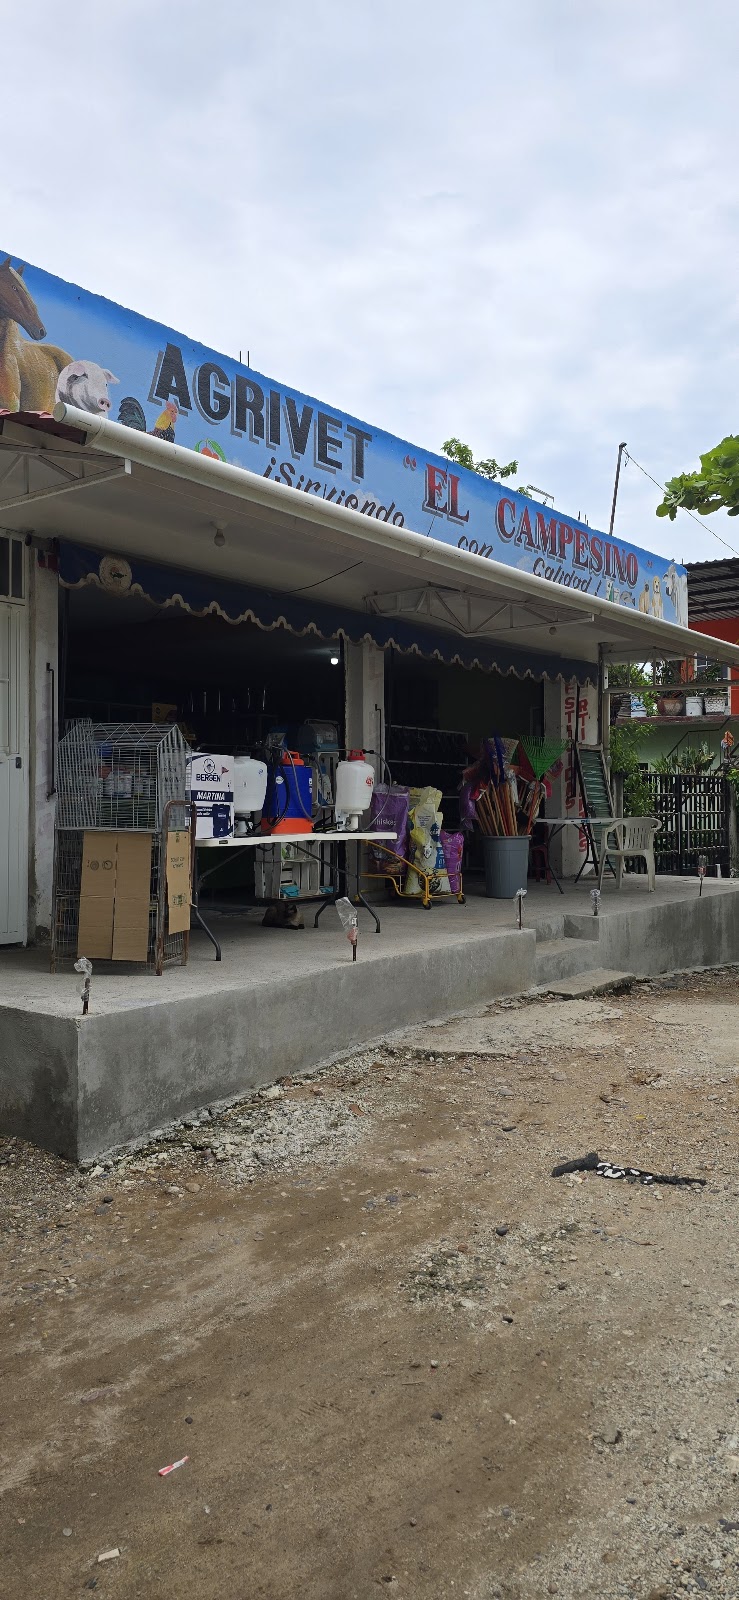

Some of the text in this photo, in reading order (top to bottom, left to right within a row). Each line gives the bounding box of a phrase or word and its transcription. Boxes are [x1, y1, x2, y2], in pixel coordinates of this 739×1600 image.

[148, 343, 372, 482] AGRIVET
[495, 497, 640, 588] CAMPESINO
[457, 536, 494, 558] con
[196, 791, 225, 801] MARTINA
